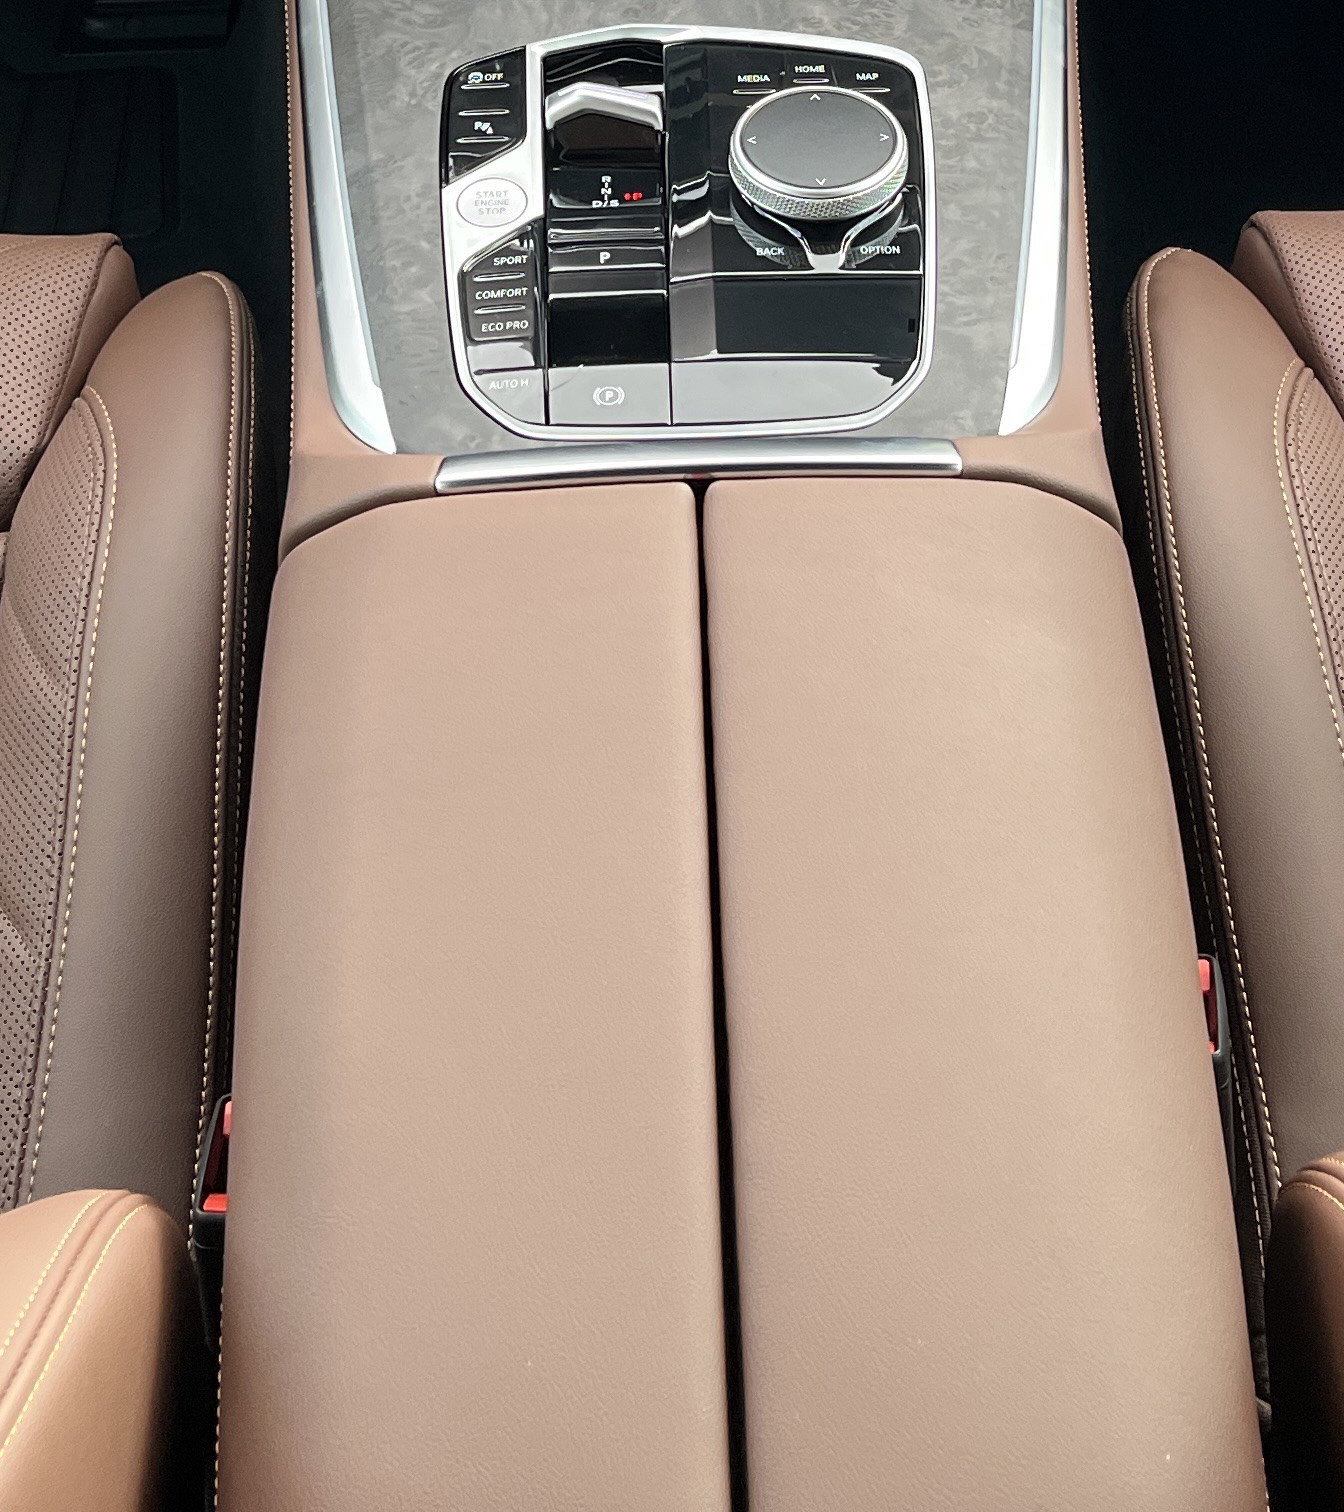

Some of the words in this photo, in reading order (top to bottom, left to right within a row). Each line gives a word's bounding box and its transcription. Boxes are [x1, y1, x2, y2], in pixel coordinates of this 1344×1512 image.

[794, 64, 825, 74] HOME
[484, 72, 504, 81] OFF
[737, 73, 770, 83] MEDIA
[855, 72, 879, 81] MAP
[601, 175, 612, 183] R
[475, 189, 509, 199] START
[601, 187, 612, 195] N
[474, 198, 510, 208] ENGINE
[478, 207, 506, 217] STOP
[756, 246, 785, 256] BACK
[859, 245, 901, 255] OPTION
[493, 254, 528, 266] SPORT
[599, 251, 611, 264] P
[475, 287, 528, 300] COMFORT
[481, 321, 504, 333] ECO
[506, 320, 529, 331] PRO
[489, 378, 519, 390] AUTO
[520, 378, 529, 387] H
